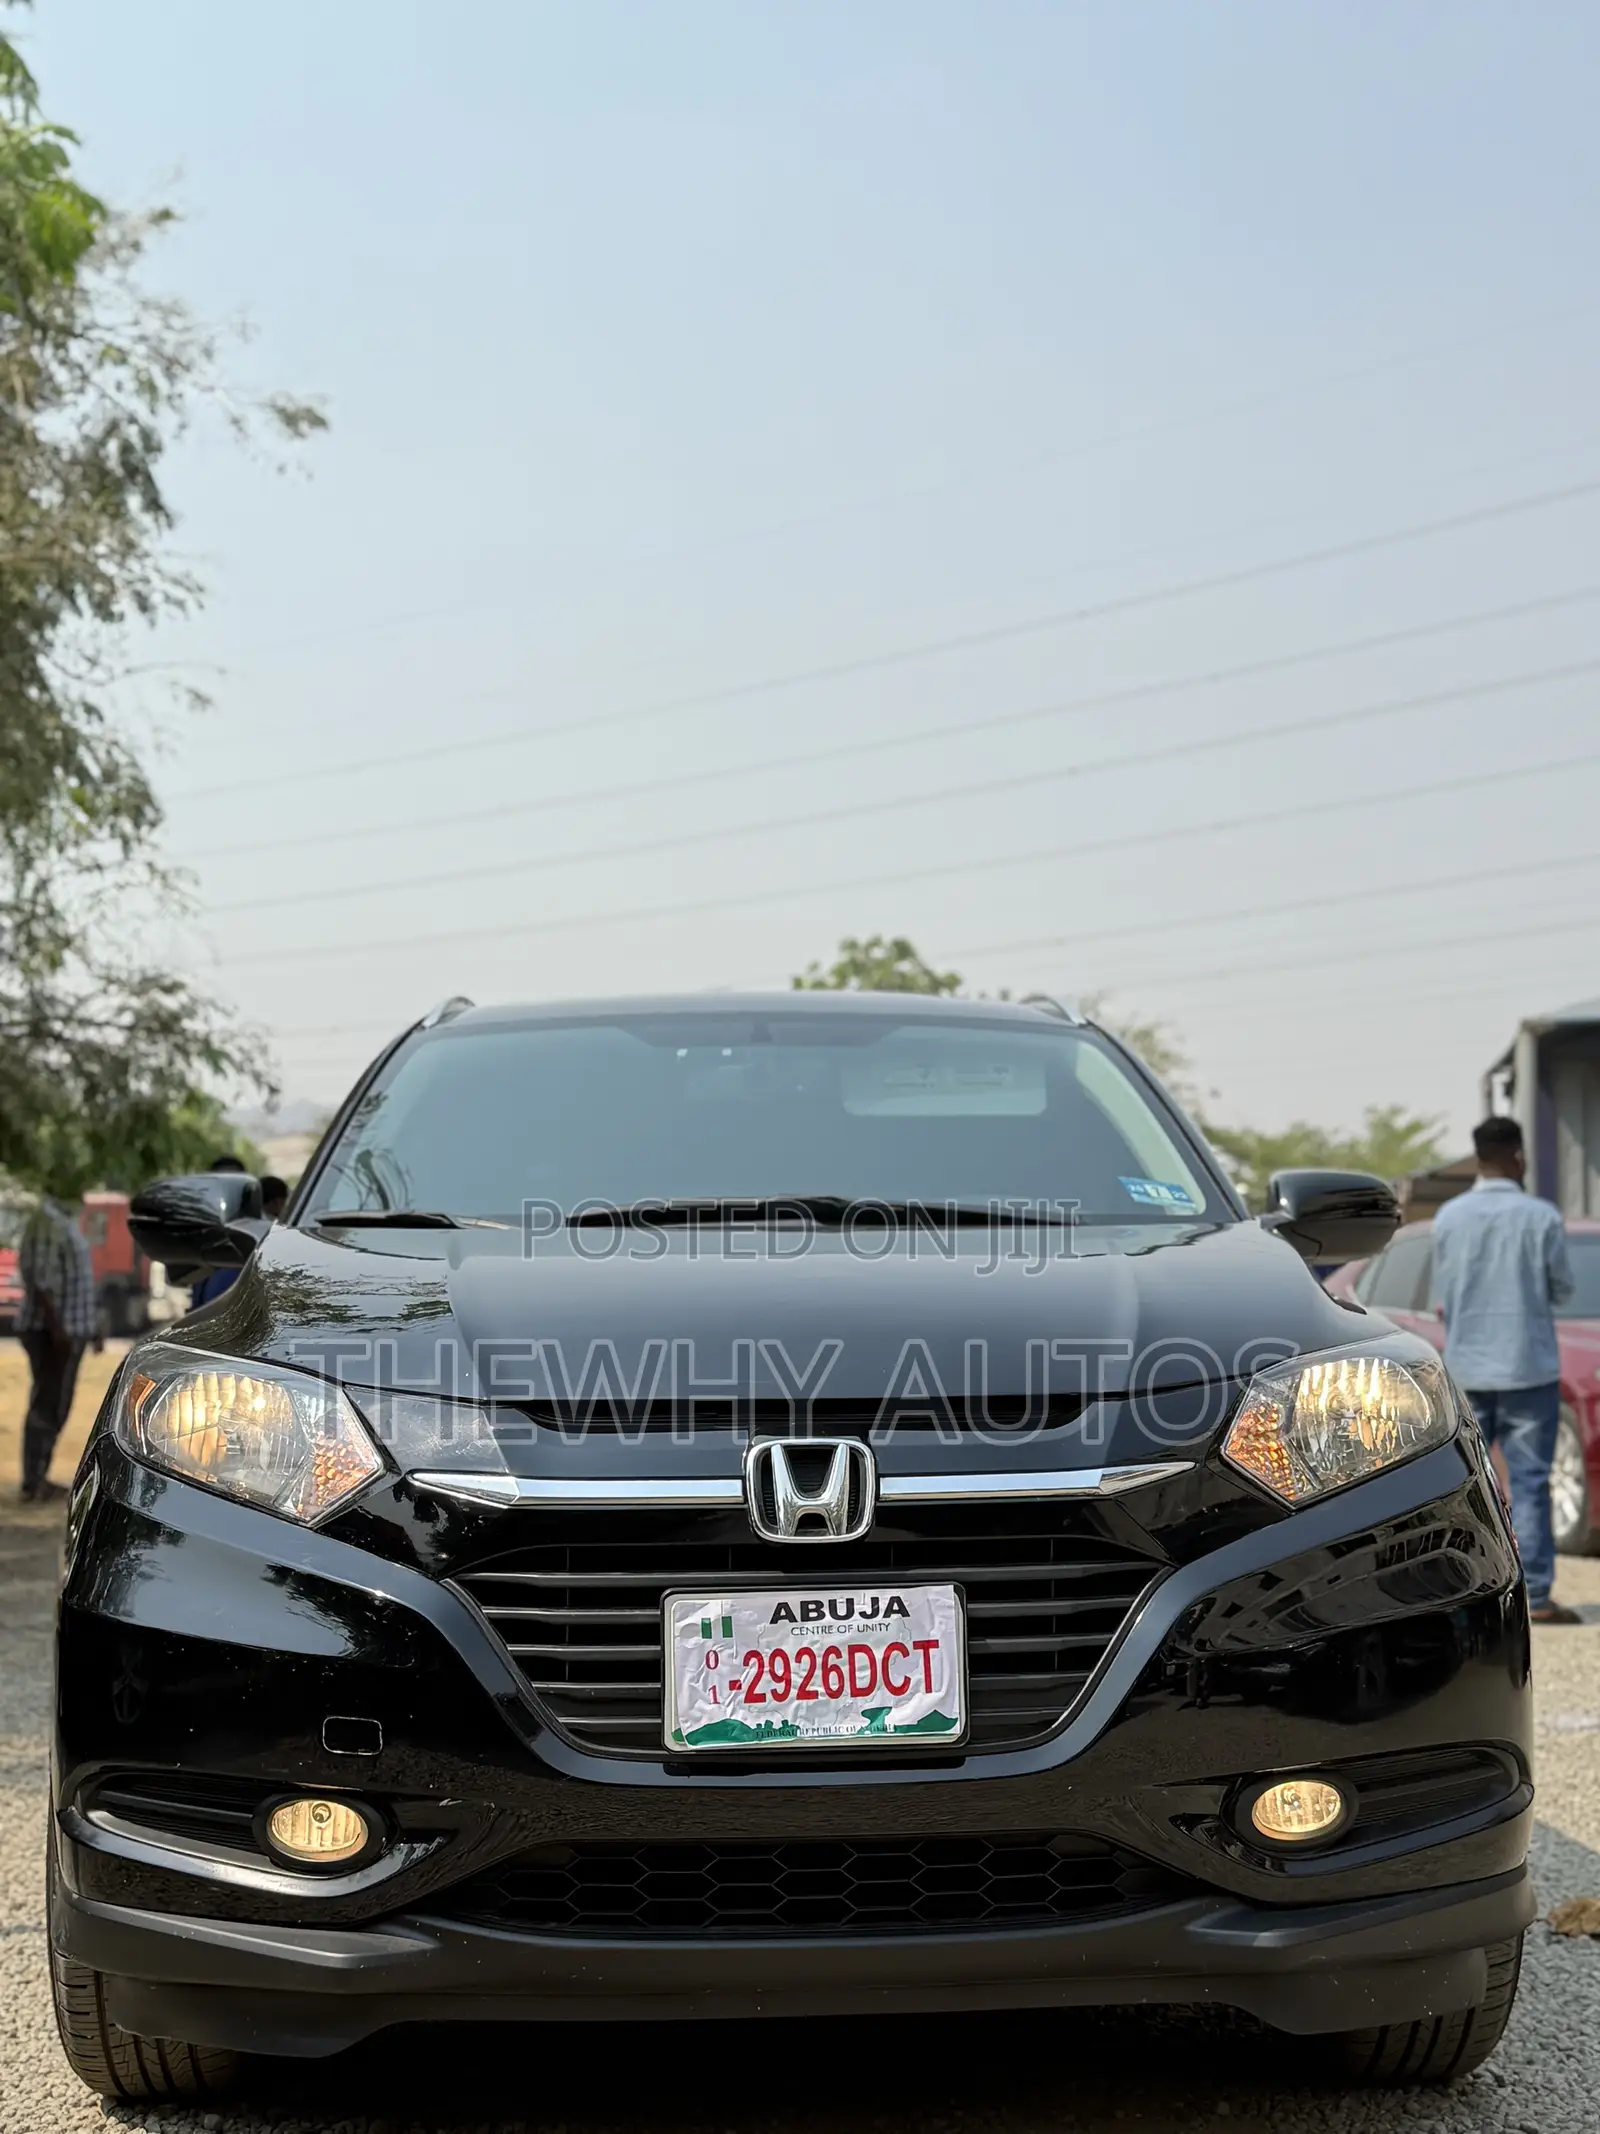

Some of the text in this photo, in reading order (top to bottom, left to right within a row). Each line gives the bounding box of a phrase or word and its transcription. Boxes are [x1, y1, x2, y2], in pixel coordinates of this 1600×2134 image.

[769, 1595, 911, 1625] ABUJA
[790, 1622, 891, 1636] CENTRE OF UNITY
